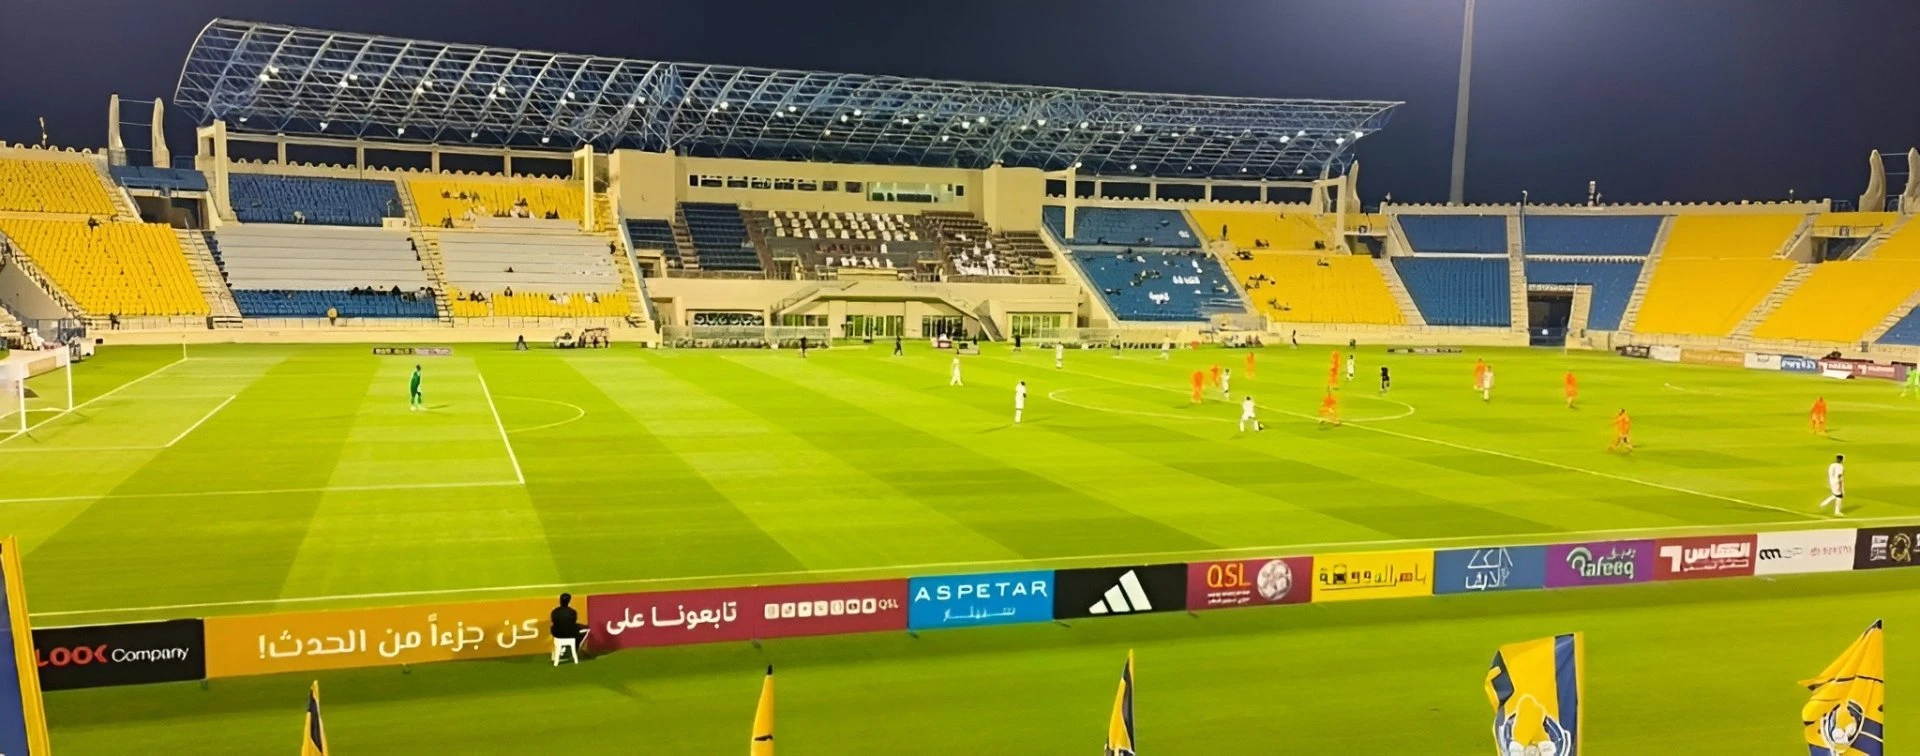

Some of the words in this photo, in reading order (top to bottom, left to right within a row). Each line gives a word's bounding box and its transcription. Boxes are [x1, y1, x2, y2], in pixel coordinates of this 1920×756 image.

[1206, 562, 1252, 588] QSL
[915, 580, 1048, 602] ASPETAR
[606, 607, 645, 635] على
[651, 601, 737, 630] تابعونا
[378, 628, 421, 658] من
[496, 618, 540, 648] كن
[111, 647, 190, 662] Company
